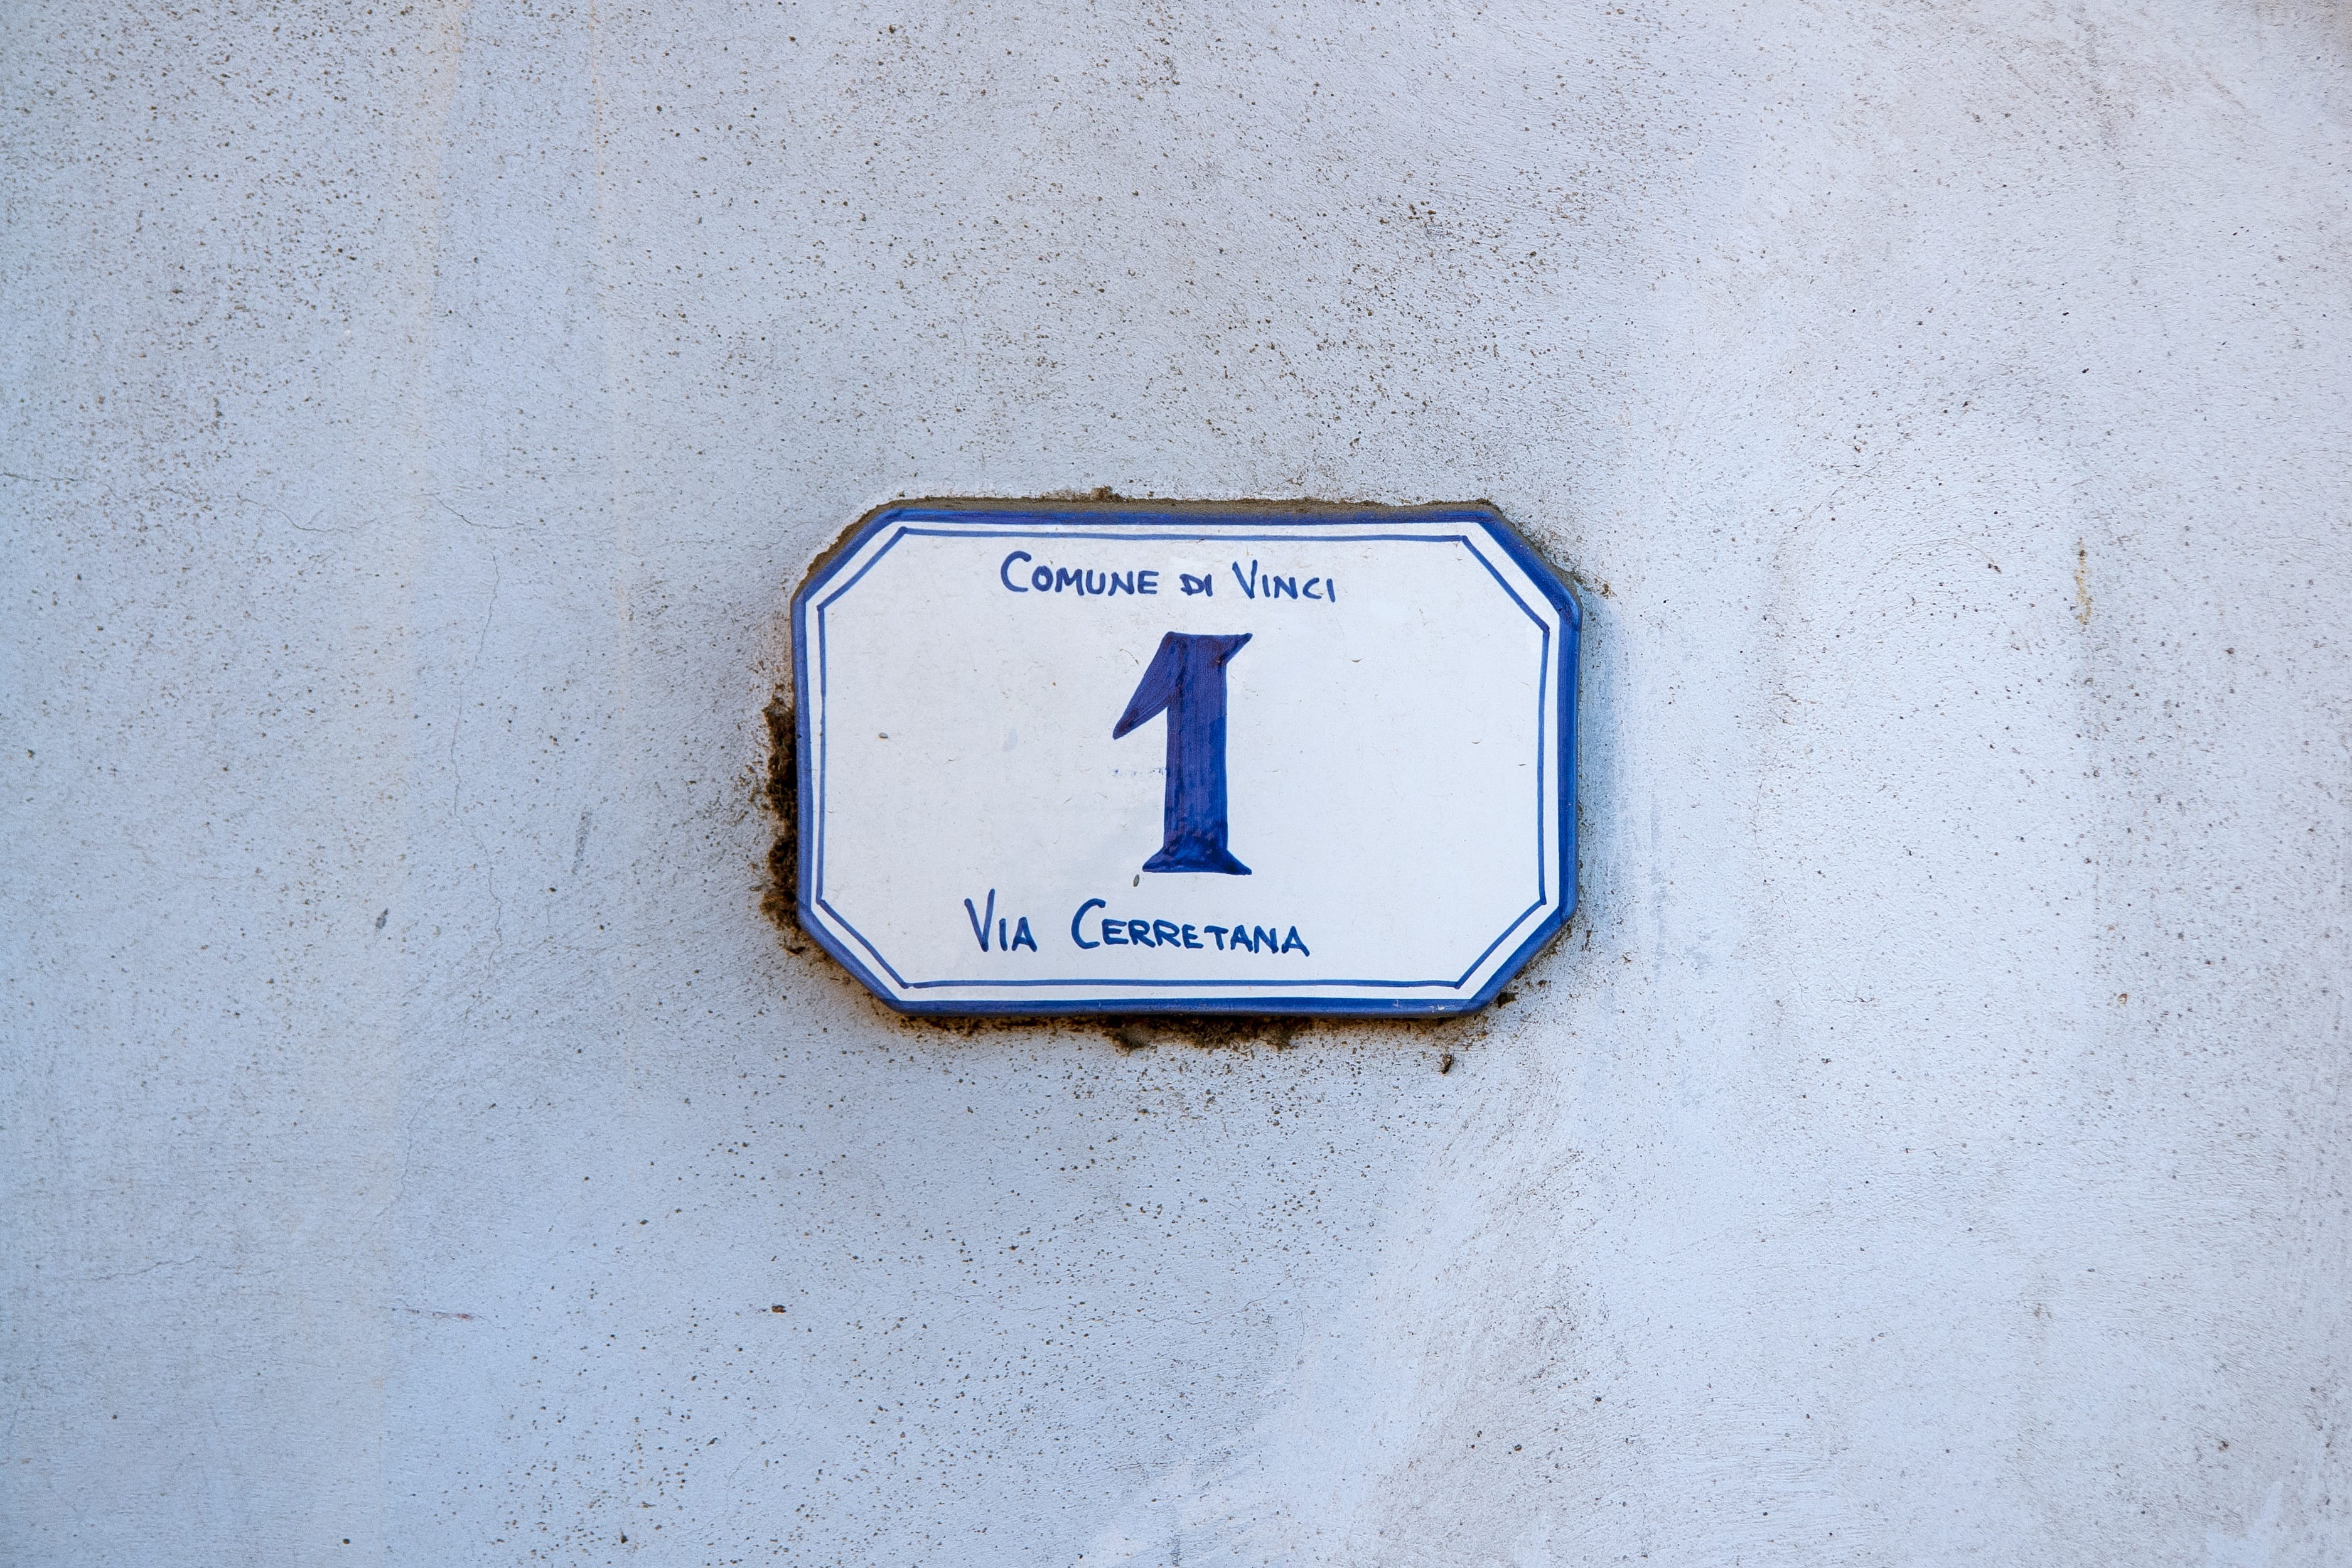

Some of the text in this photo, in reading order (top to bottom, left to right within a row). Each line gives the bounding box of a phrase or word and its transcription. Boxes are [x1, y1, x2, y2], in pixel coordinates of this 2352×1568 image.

[1001, 550, 1336, 603] COMUNE DI VINCI
[1112, 631, 1253, 876] 1
[964, 888, 1310, 957] VIA CERRETANA
